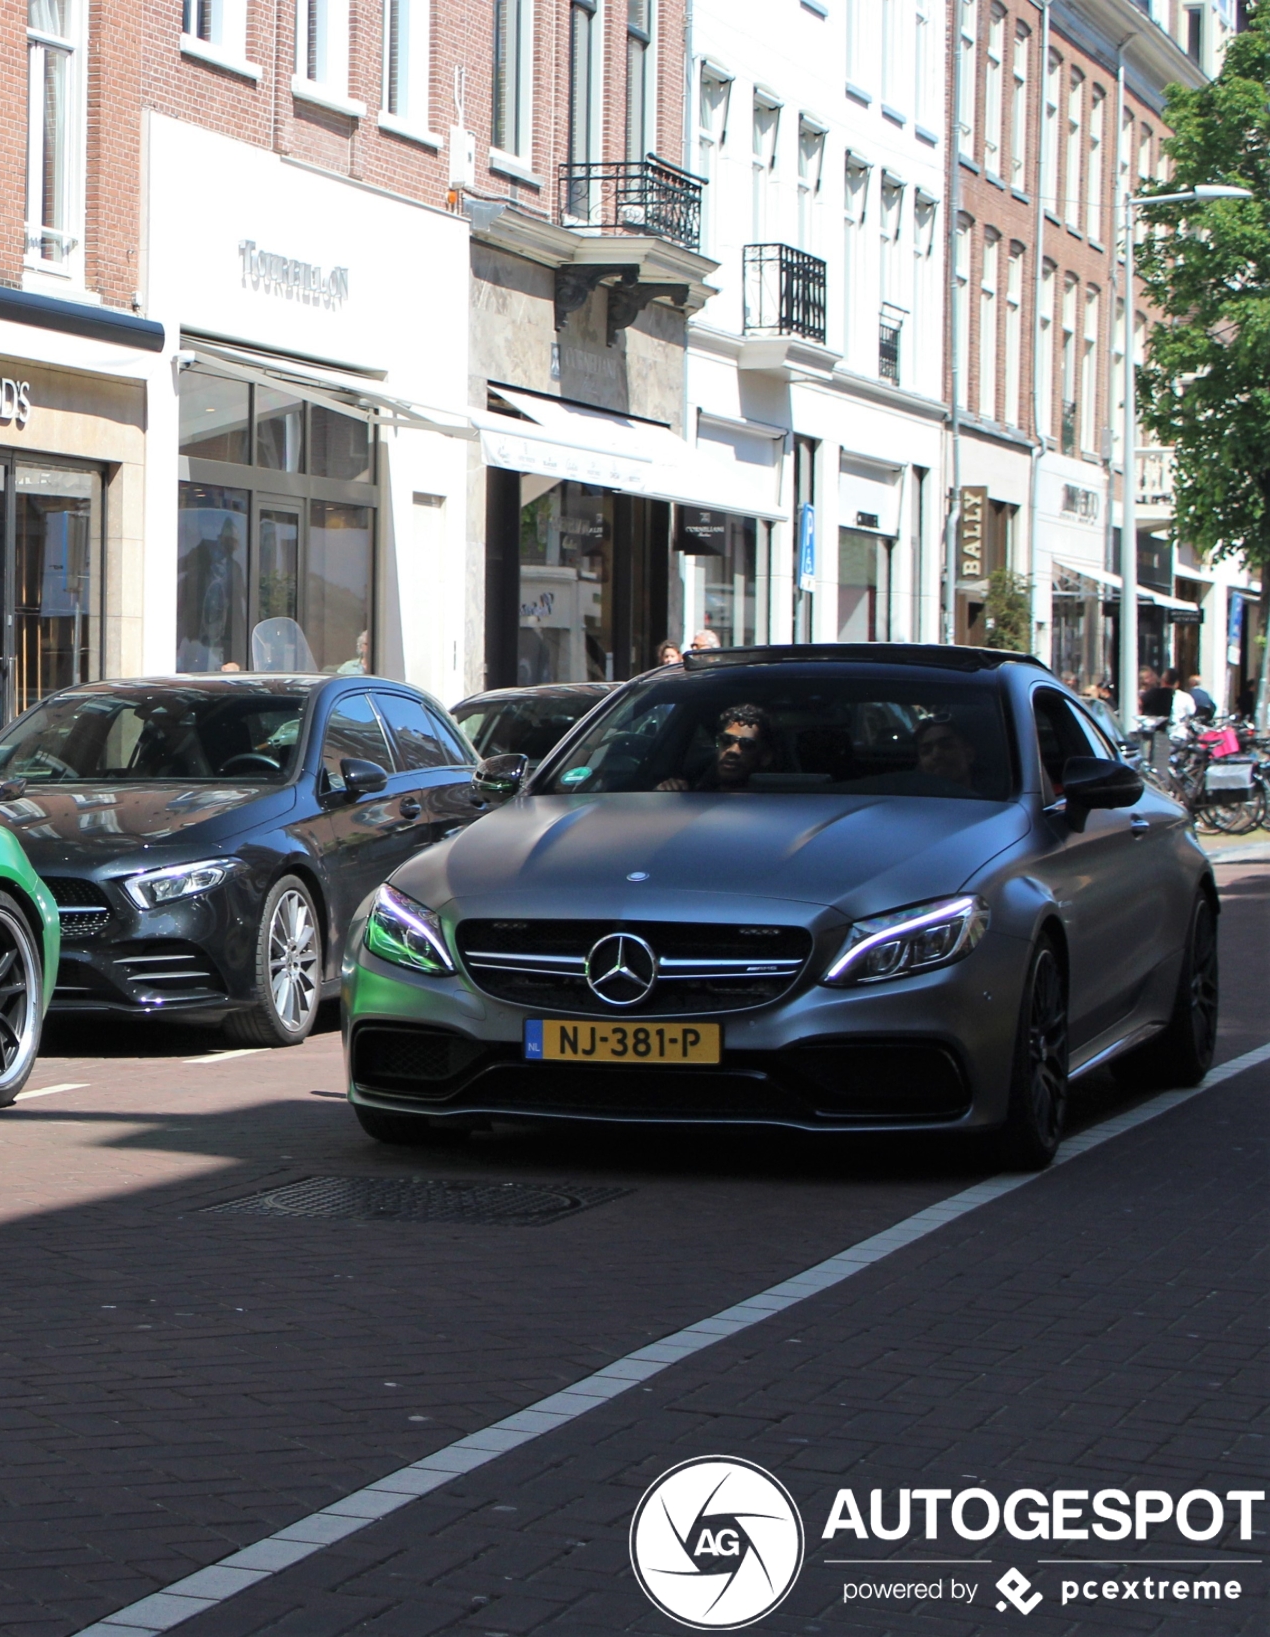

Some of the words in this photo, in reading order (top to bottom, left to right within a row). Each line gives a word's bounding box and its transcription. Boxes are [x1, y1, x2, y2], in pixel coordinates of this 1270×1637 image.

[962, 490, 983, 576] BALLY
[528, 1042, 540, 1052] NL
[559, 1025, 701, 1058] NJ-381-P
